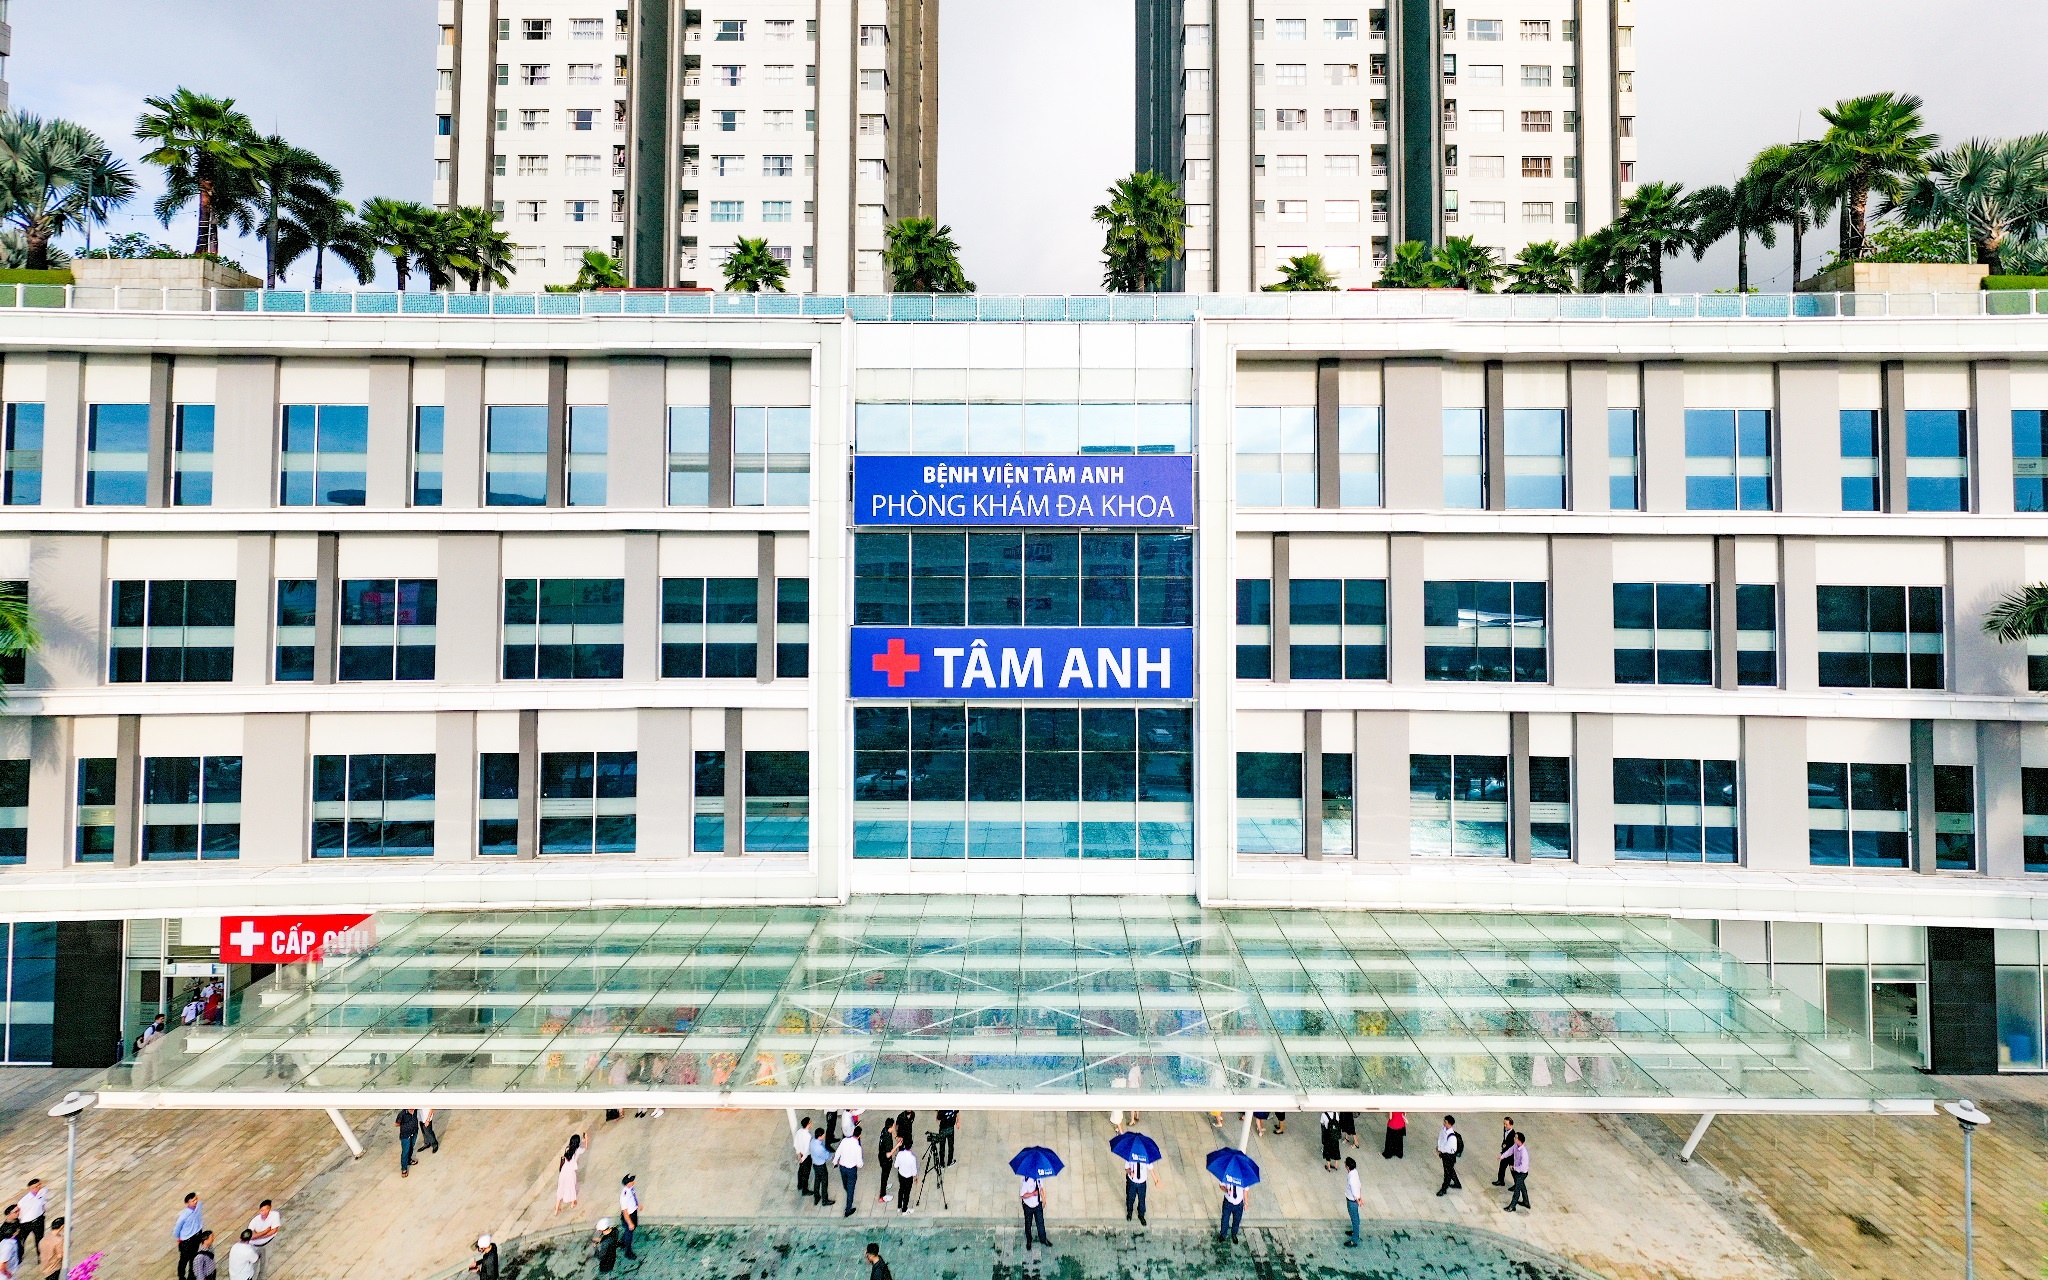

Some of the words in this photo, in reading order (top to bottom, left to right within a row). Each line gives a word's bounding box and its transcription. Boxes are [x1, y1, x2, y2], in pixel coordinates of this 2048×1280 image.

[922, 462, 979, 489] BỆNH
[981, 462, 1029, 489] VIỆN
[1032, 462, 1077, 484] TÂM
[1080, 466, 1125, 484] ANH
[872, 489, 966, 517] PHÒNG
[973, 490, 1050, 517] KHÁM
[1056, 494, 1095, 517] ĐA
[1101, 494, 1175, 518] KHOA
[933, 638, 1044, 688] TÂM
[1058, 647, 1171, 689] ANH
[271, 922, 316, 955] CẤP
